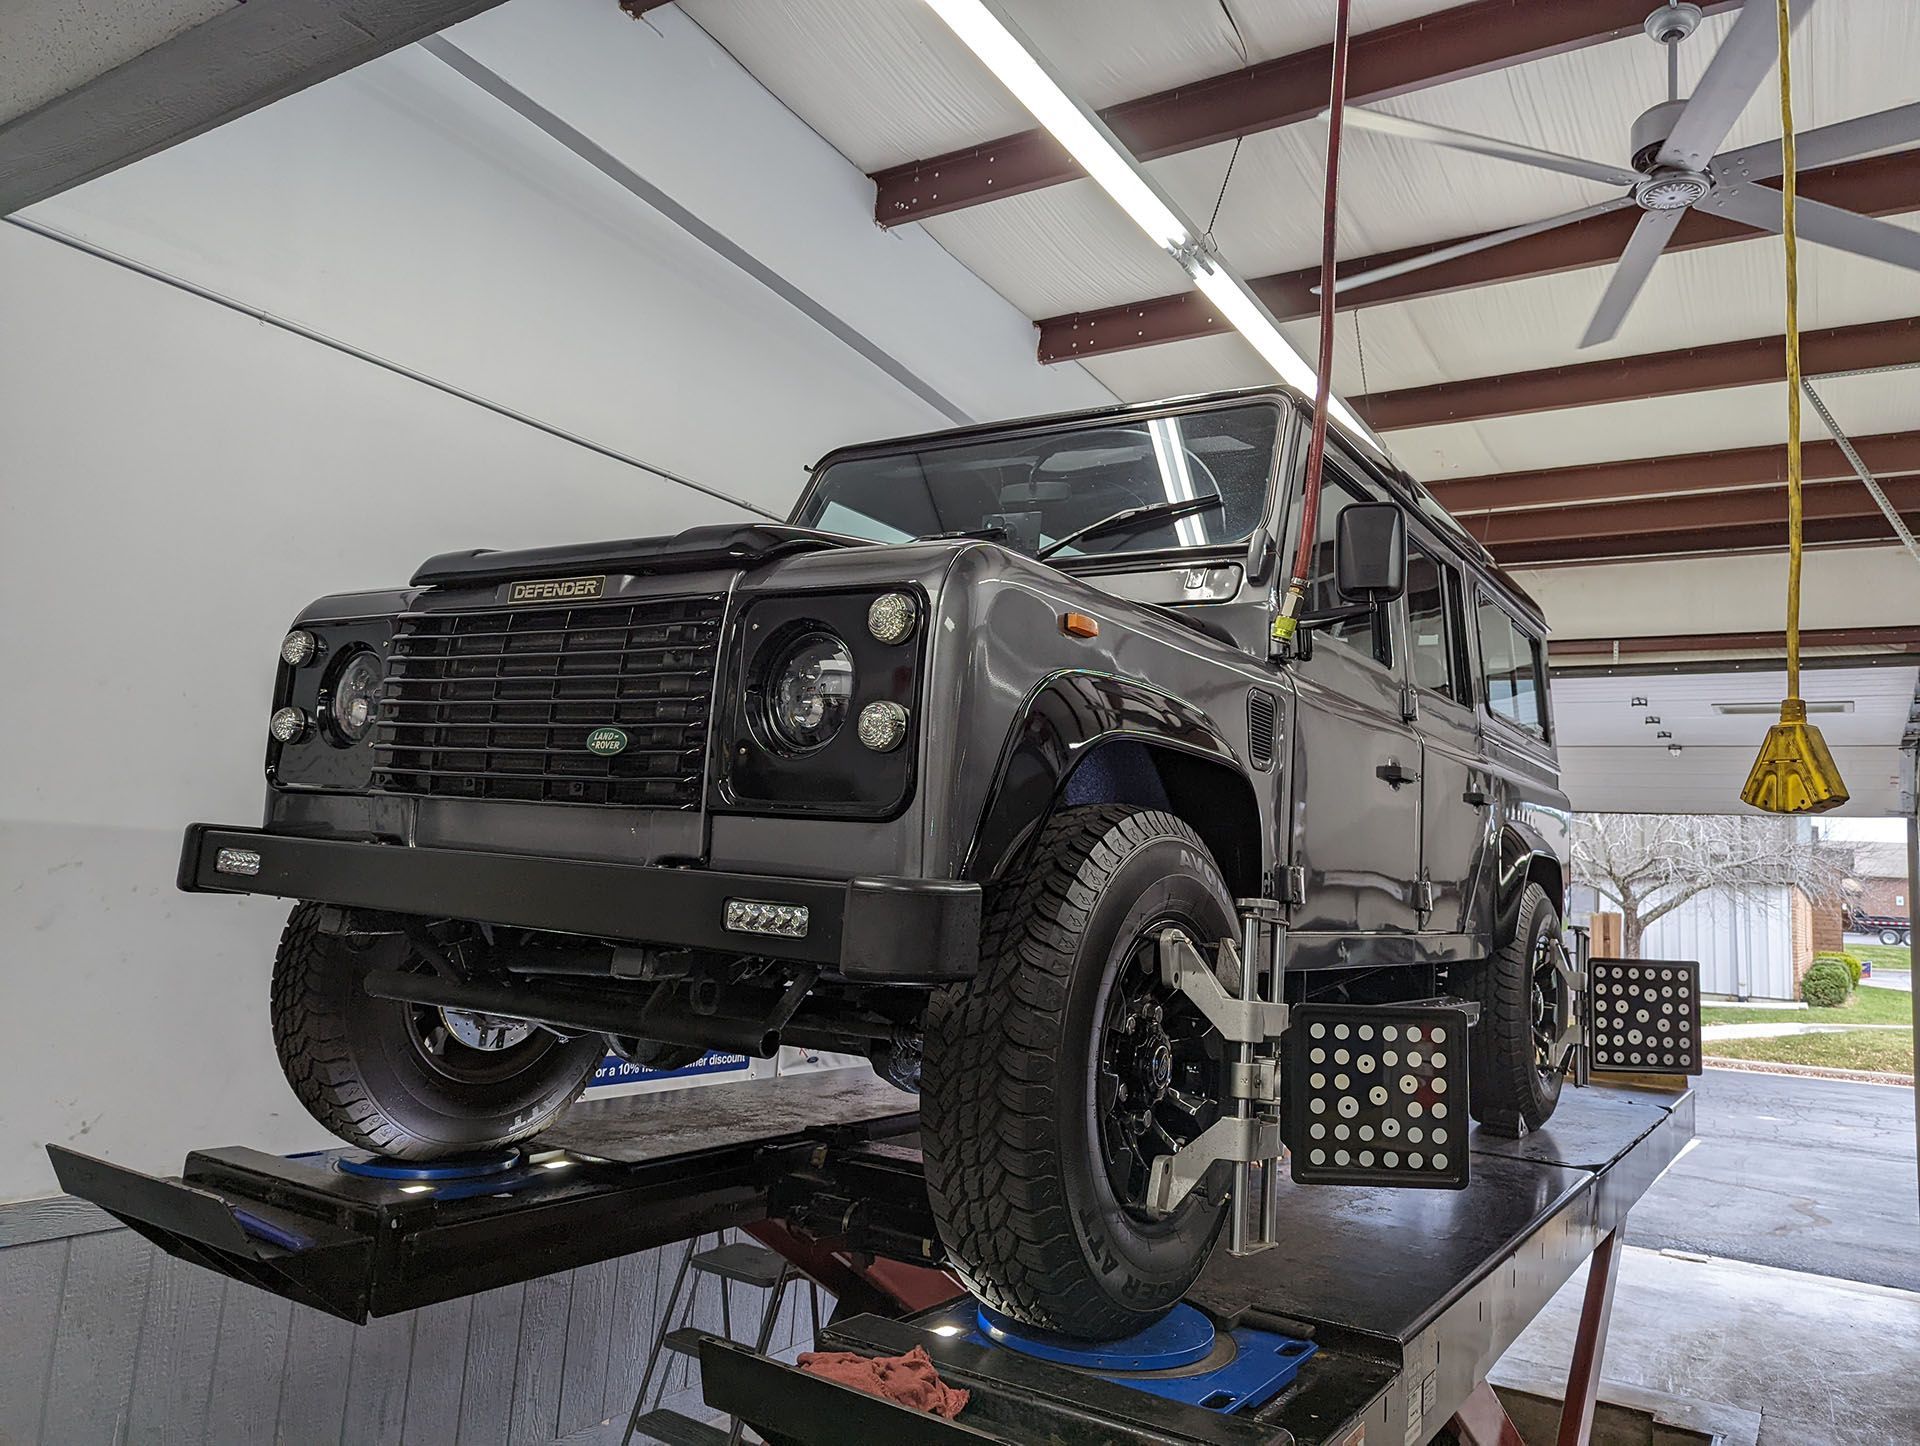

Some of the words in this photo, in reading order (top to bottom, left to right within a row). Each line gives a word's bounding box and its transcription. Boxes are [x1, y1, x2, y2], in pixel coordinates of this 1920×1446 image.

[514, 580, 597, 599] DEFENDER
[1179, 849, 1229, 905] AVON
[608, 1066, 616, 1077] a
[618, 1062, 640, 1075] 10%
[709, 1053, 746, 1066] discount
